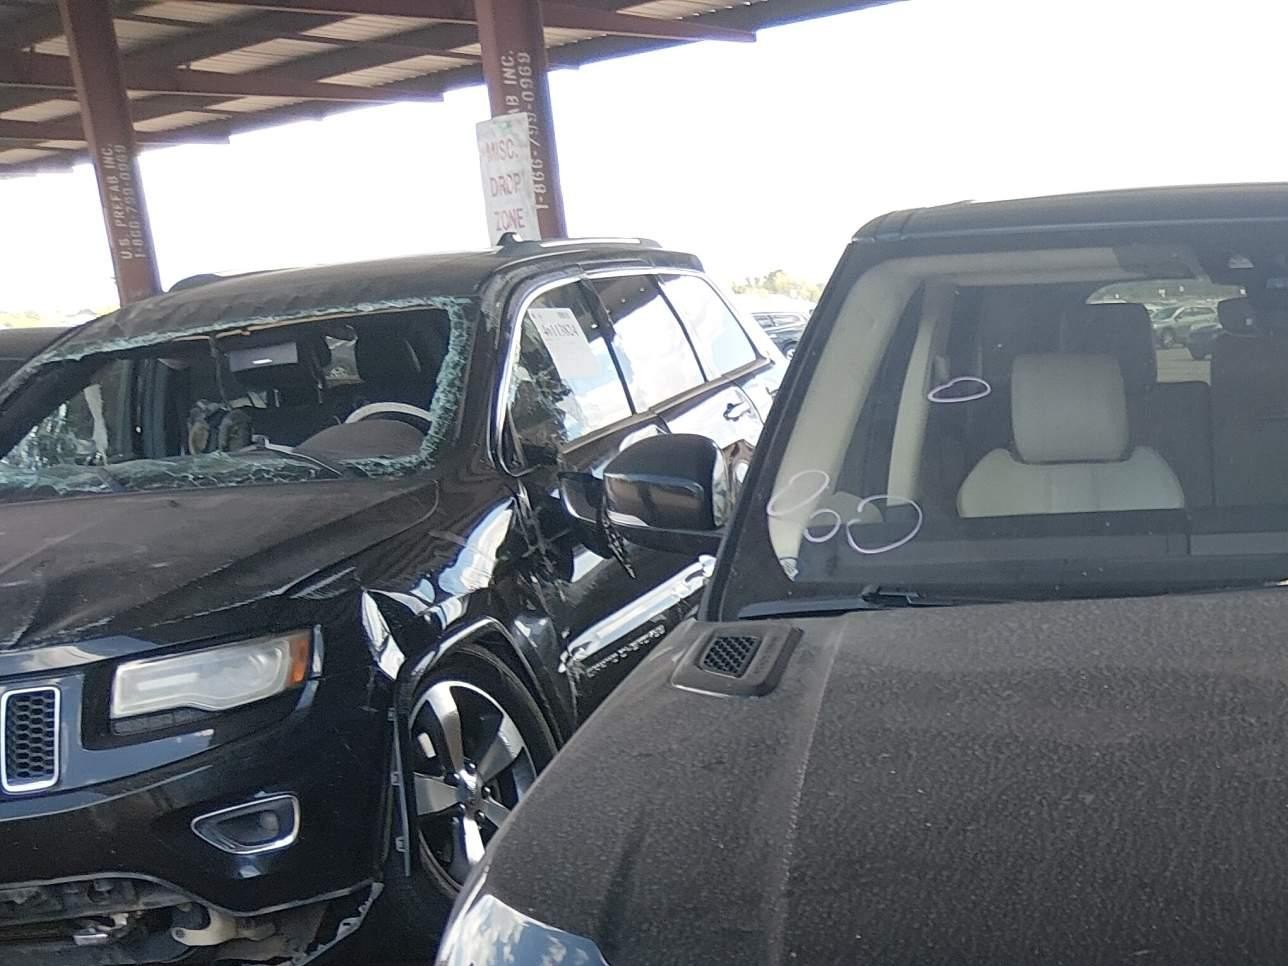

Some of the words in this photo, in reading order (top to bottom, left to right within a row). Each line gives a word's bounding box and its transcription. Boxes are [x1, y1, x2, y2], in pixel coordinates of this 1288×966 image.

[501, 50, 517, 85] INC.
[489, 172, 523, 198] DROP
[106, 175, 128, 228] PREFAB
[493, 207, 526, 232] ZONE
